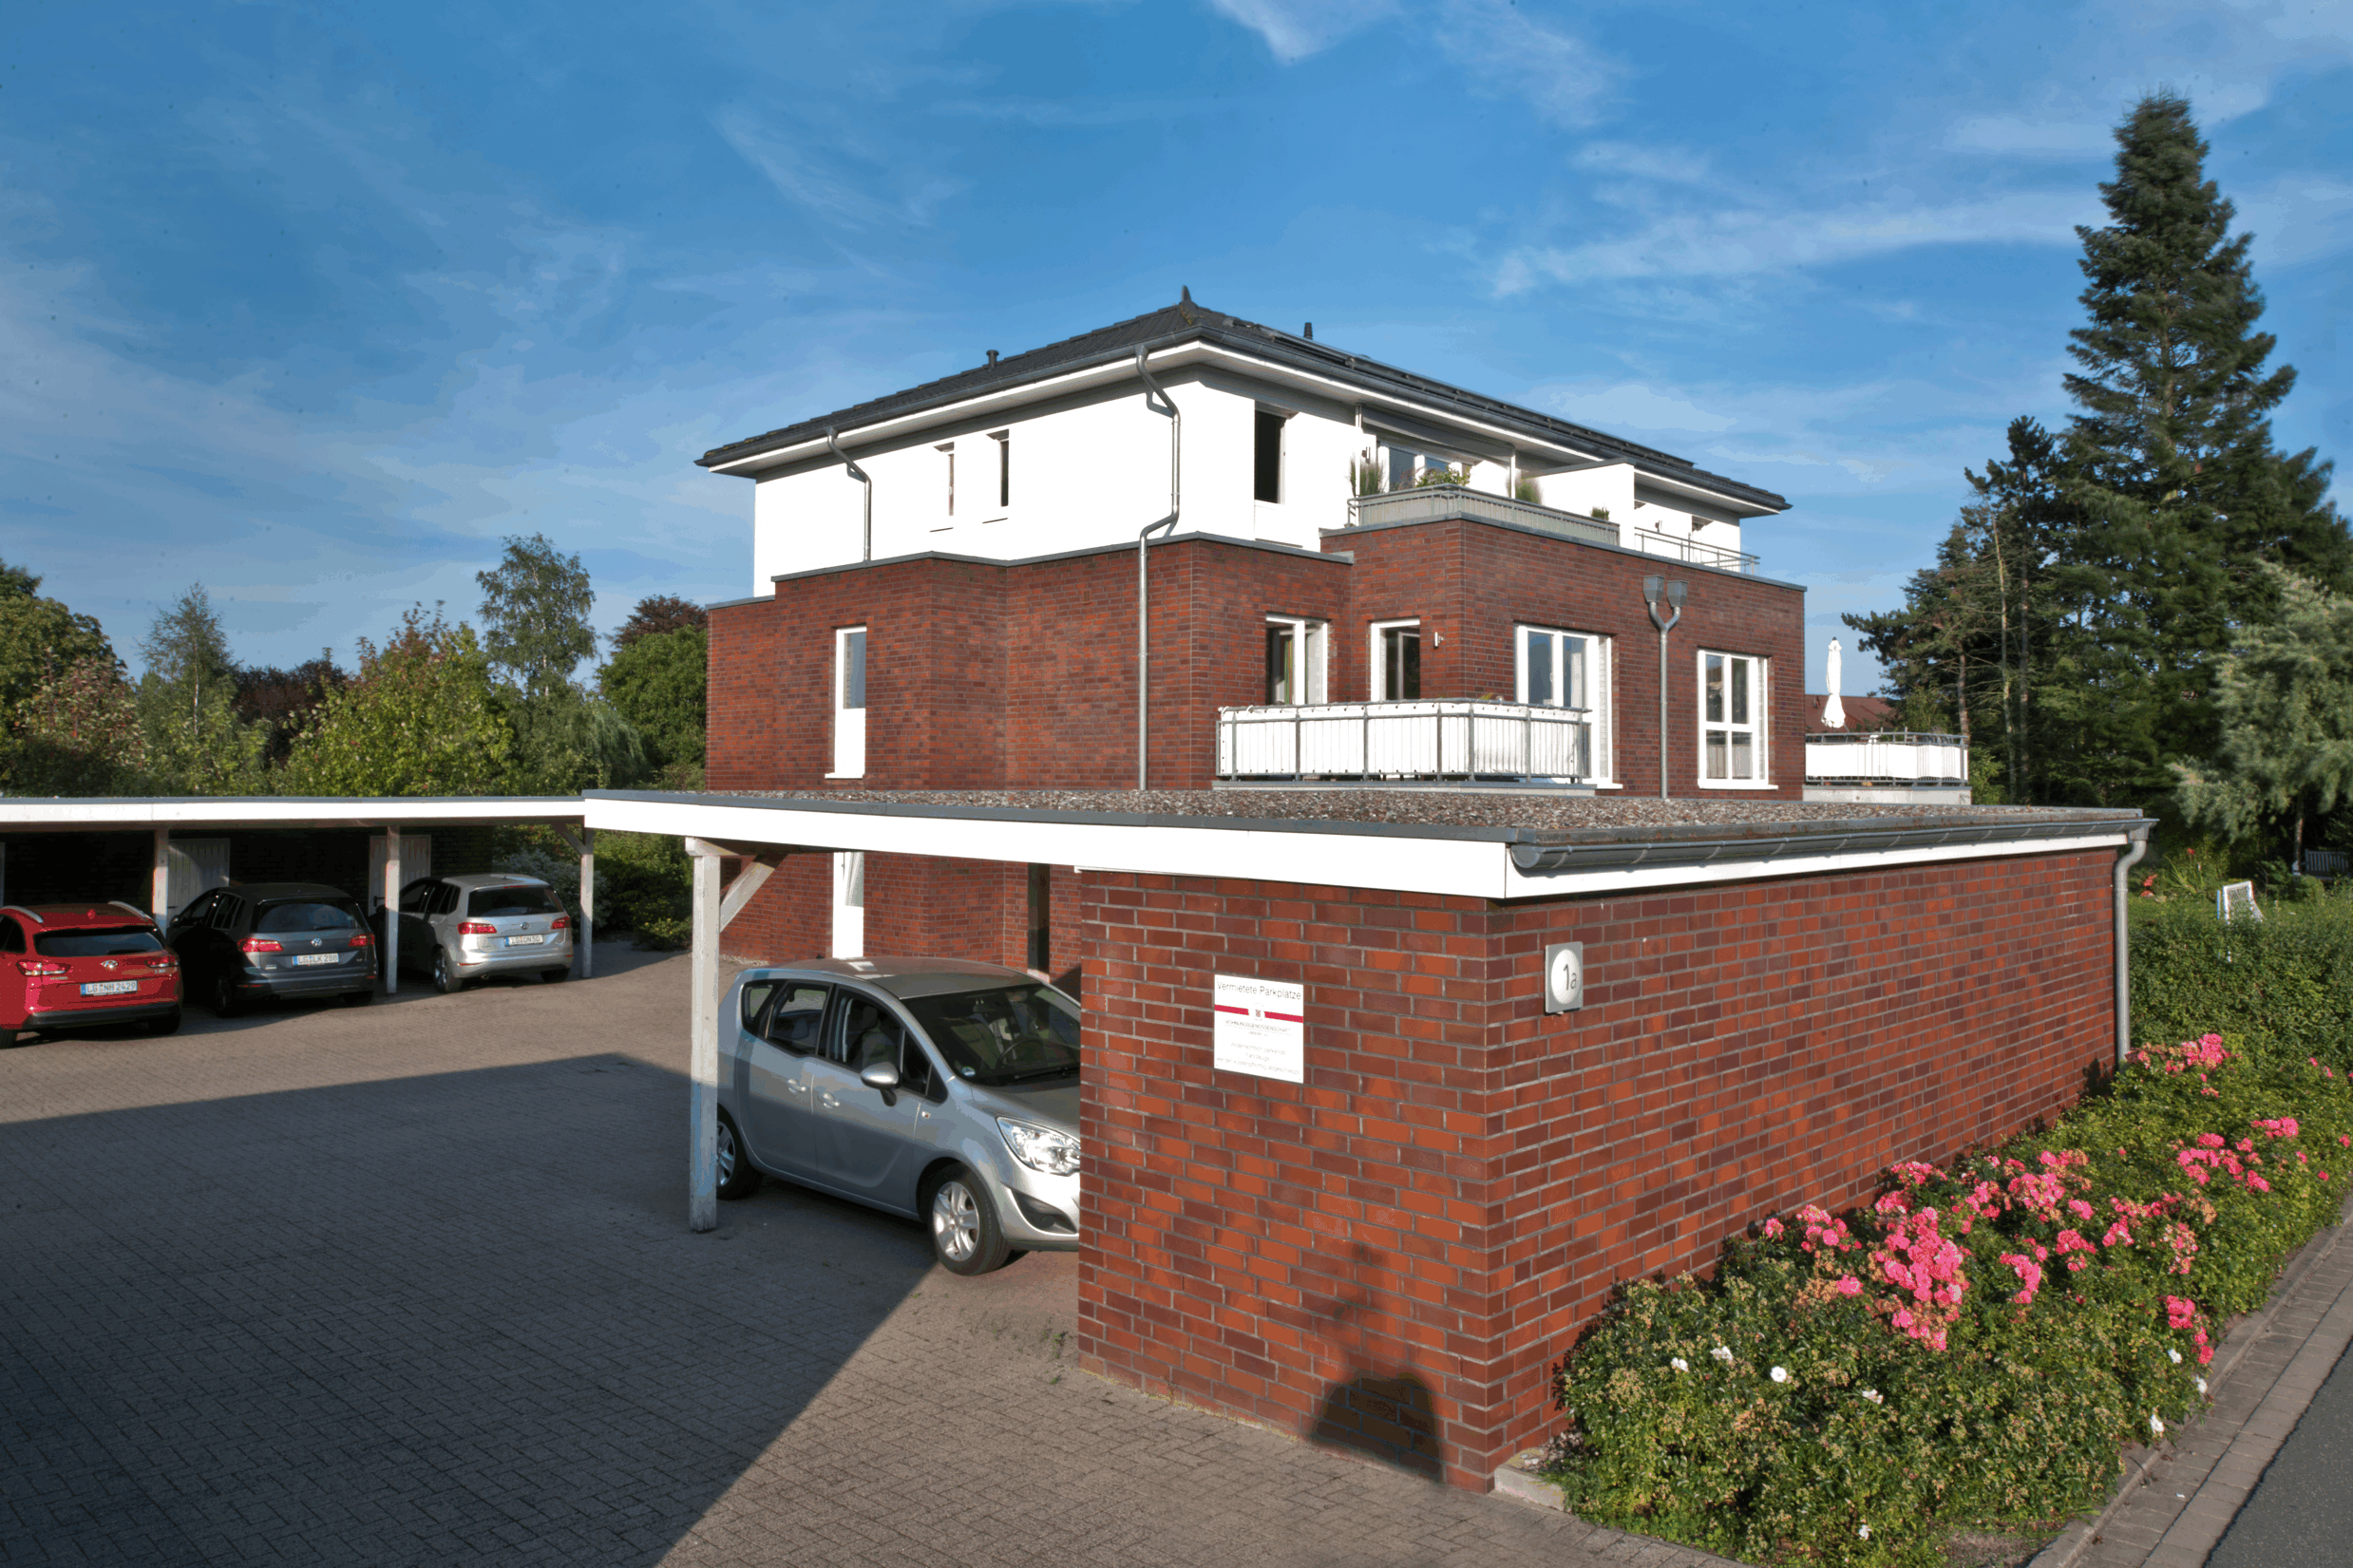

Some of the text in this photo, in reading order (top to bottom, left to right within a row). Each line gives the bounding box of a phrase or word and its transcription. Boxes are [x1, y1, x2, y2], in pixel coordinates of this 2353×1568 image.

[297, 955, 309, 964] LG
[1563, 963, 1577, 991] 1a
[86, 984, 98, 993] LG
[115, 981, 136, 992] 2429
[1217, 981, 1258, 994] Vermietete
